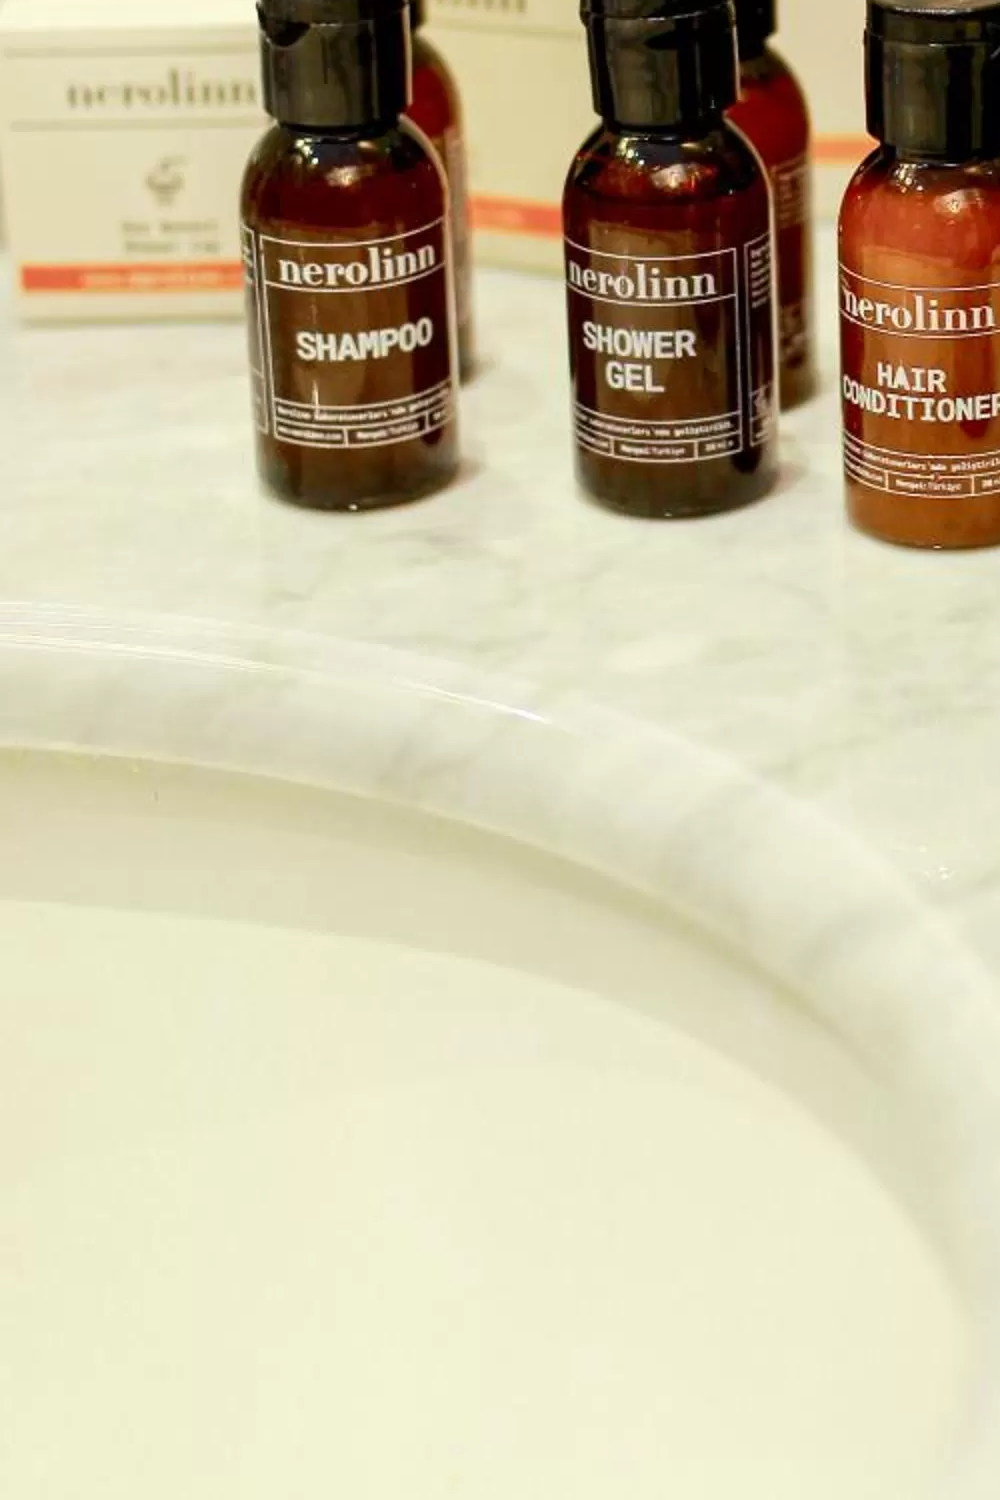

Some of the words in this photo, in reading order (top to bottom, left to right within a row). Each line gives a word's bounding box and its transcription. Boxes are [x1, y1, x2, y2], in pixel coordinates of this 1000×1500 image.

[278, 244, 436, 286] nerolinn
[568, 260, 718, 300] nerolinn
[842, 286, 996, 332] nerolinn
[296, 316, 434, 362] SHAMPOO
[582, 320, 698, 359] SHOWER
[605, 360, 666, 394] GEL
[876, 361, 948, 394] HAIR
